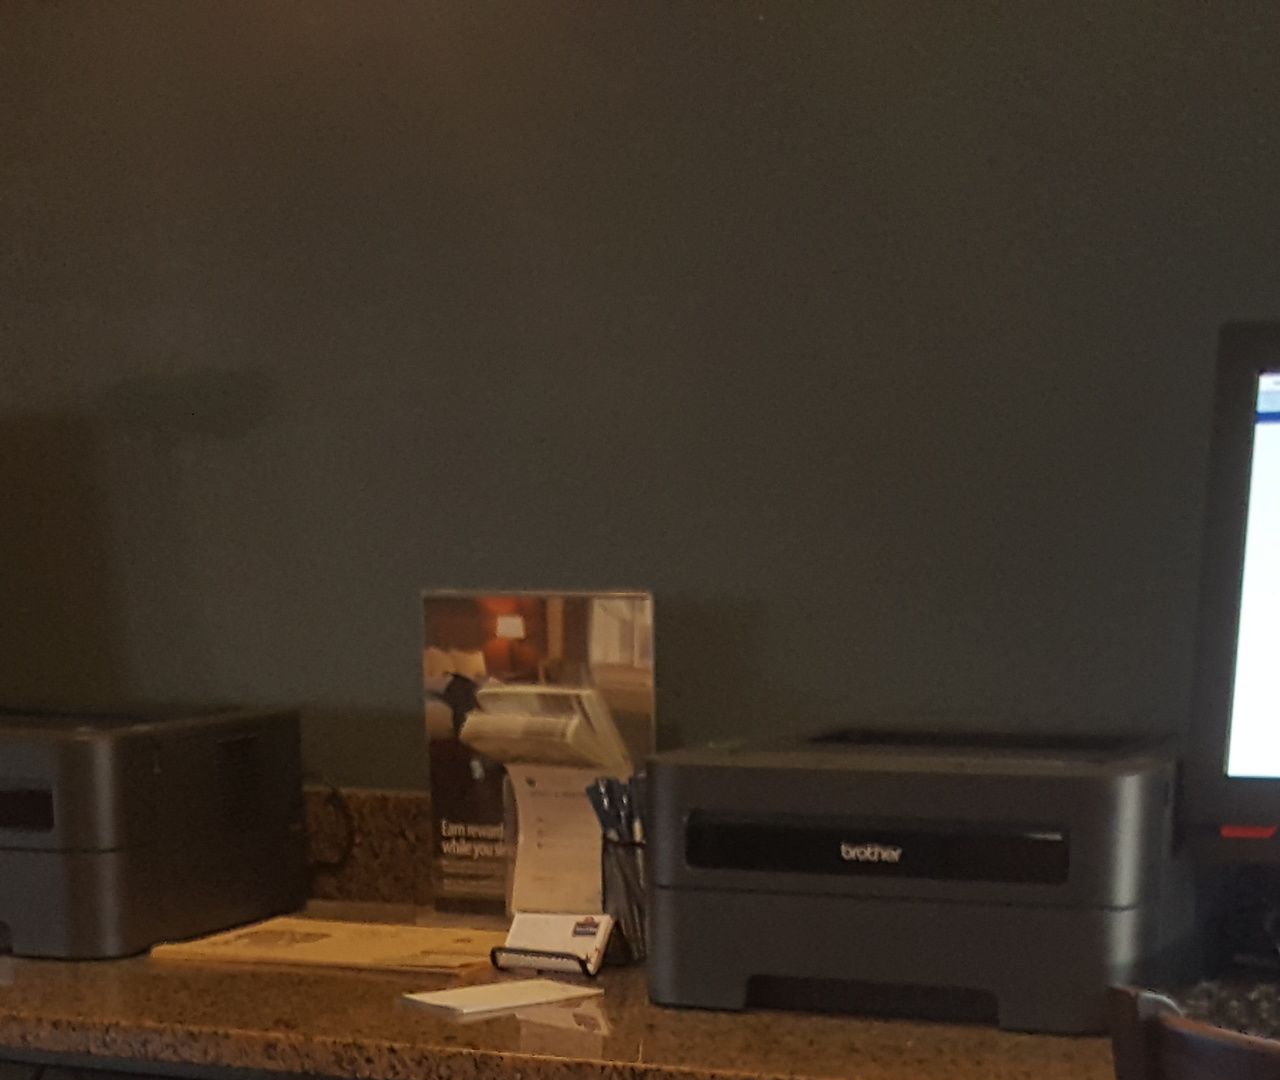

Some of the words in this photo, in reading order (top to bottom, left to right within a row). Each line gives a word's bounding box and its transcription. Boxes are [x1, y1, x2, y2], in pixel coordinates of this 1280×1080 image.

[441, 819, 465, 838] Earn
[441, 838, 472, 856] while
[473, 844, 494, 860] you
[840, 841, 902, 862] brother
